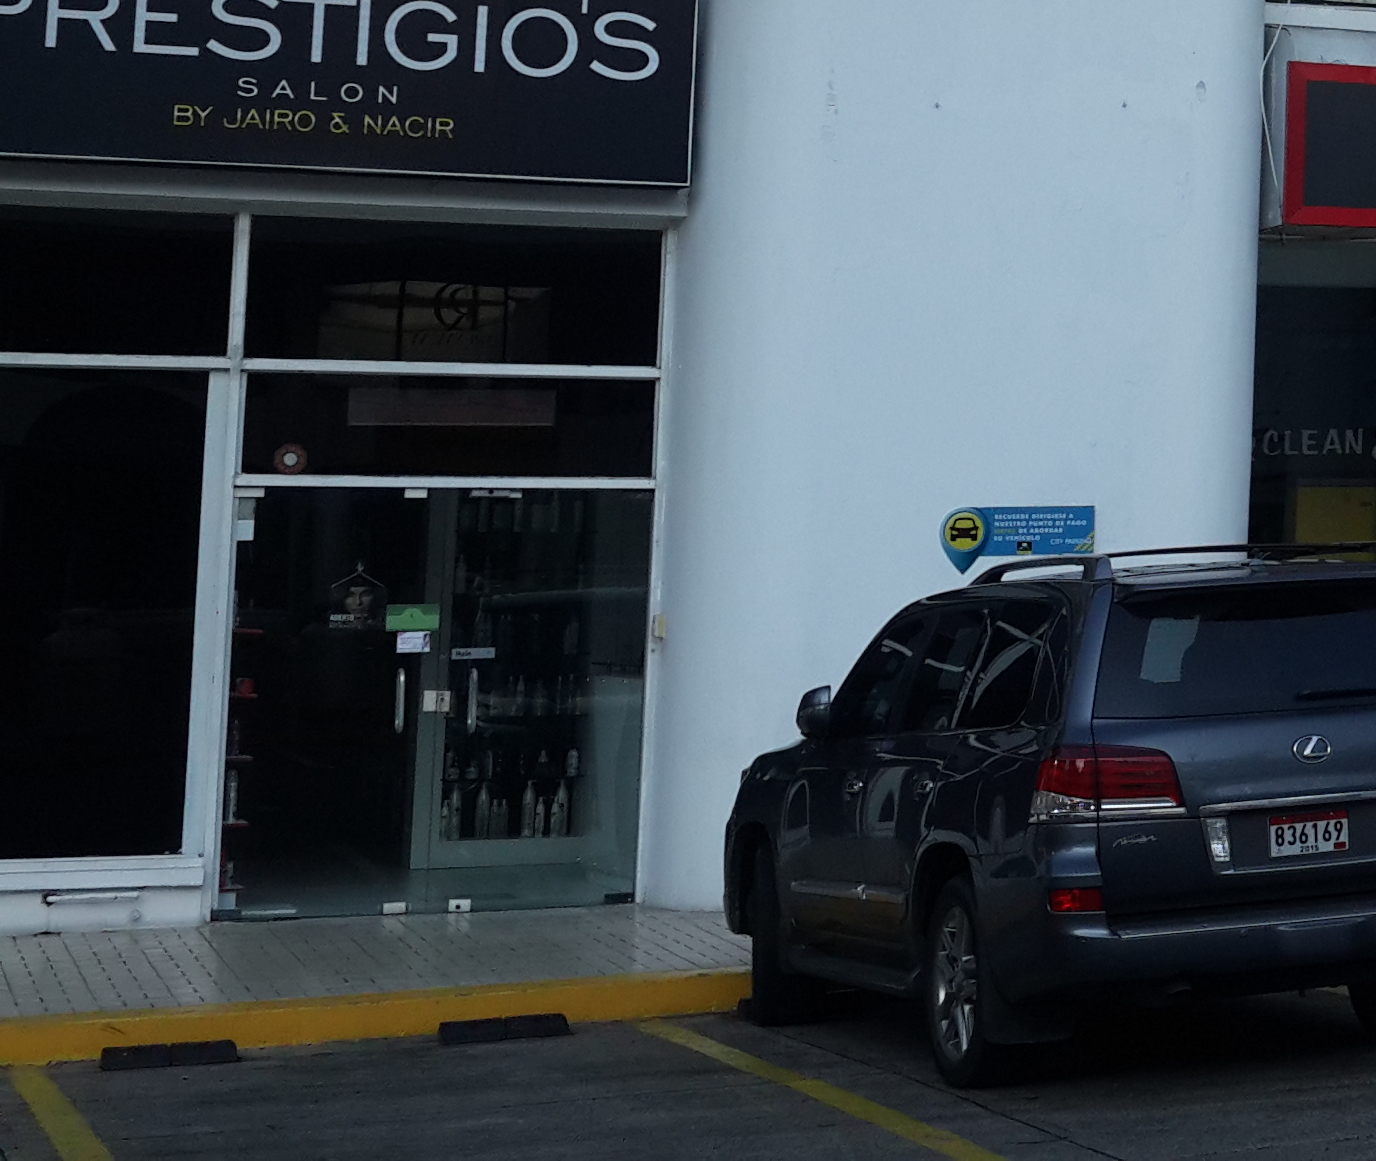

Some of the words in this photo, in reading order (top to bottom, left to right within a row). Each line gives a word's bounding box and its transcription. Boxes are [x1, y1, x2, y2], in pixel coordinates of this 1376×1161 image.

[236, 77, 398, 104] SALON
[172, 104, 212, 127] BY
[223, 108, 316, 132] JAIRO
[329, 112, 350, 134] &
[363, 114, 455, 139] NACIR
[1262, 427, 1364, 456] CLEAN
[1275, 820, 1343, 847] 836169
